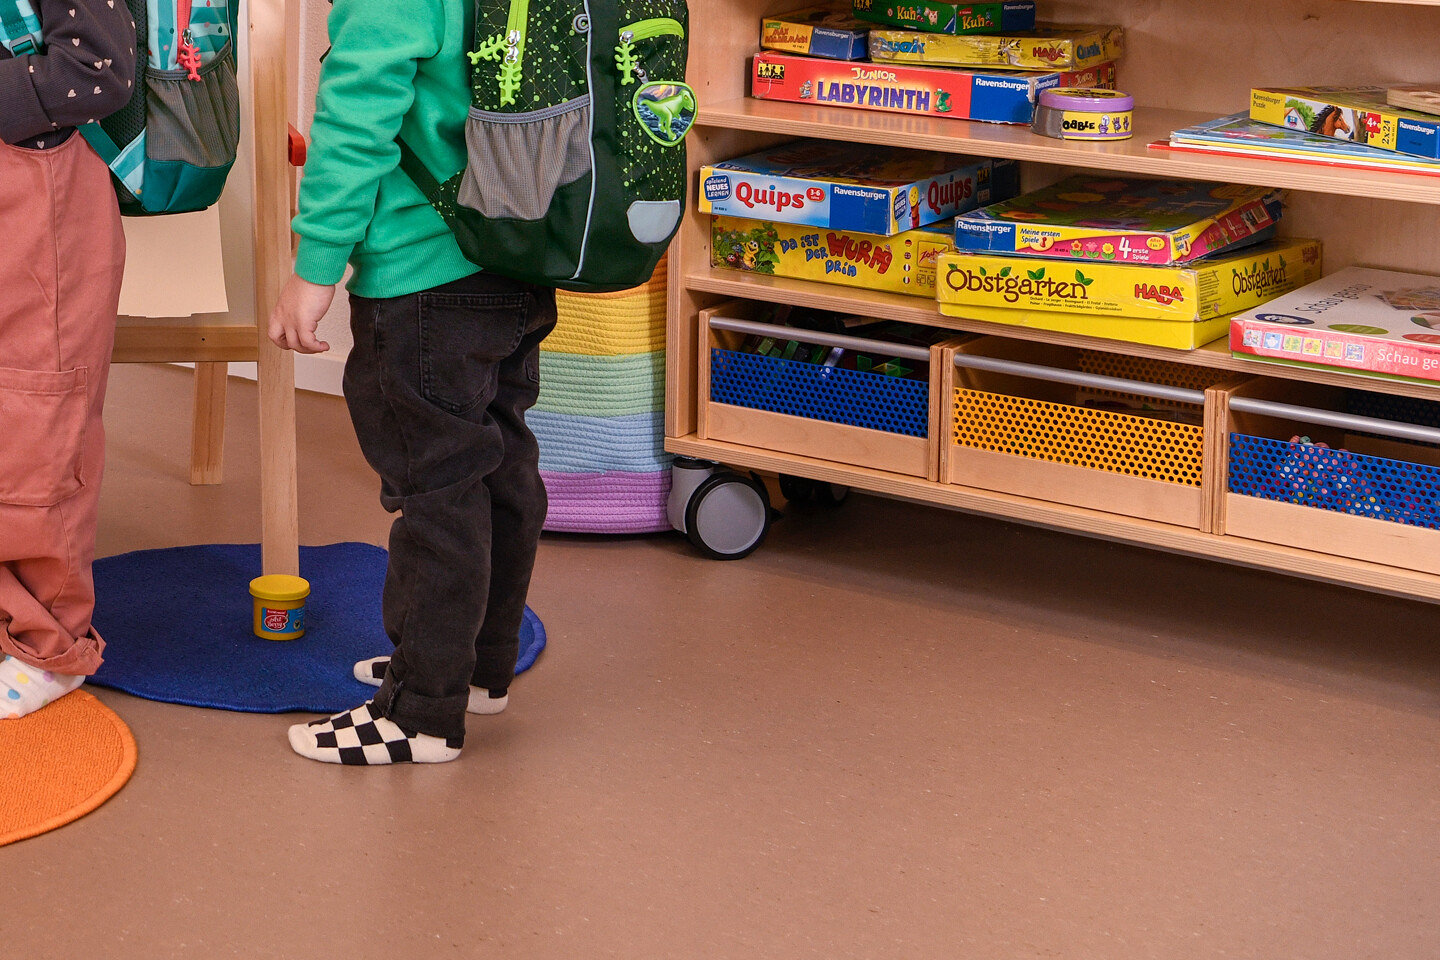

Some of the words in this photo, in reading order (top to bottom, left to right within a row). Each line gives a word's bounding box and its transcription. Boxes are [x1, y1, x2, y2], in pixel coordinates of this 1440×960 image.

[962, 14, 985, 30] Kuh
[815, 28, 850, 39] Ravensburger
[975, 77, 1030, 91] Ravensburger
[817, 81, 931, 111] LABYRINTH
[1399, 121, 1435, 135] Ravensburger
[706, 183, 729, 191] NEUES
[834, 186, 887, 201] Ravensburger
[928, 174, 973, 215] Quips
[735, 181, 805, 212] Quips
[957, 221, 1012, 233] Ravensburger
[1020, 228, 1040, 236] Meine
[1040, 229, 1061, 238] ersten
[1021, 236, 1039, 244] Spiele
[1119, 237, 1132, 259] 4
[826, 233, 893, 274] WURM
[946, 268, 1088, 303] Obstgarten
[1232, 266, 1286, 298] Obstgarten
[1134, 282, 1184, 306] HABA
[1377, 349, 1418, 366] Schau
